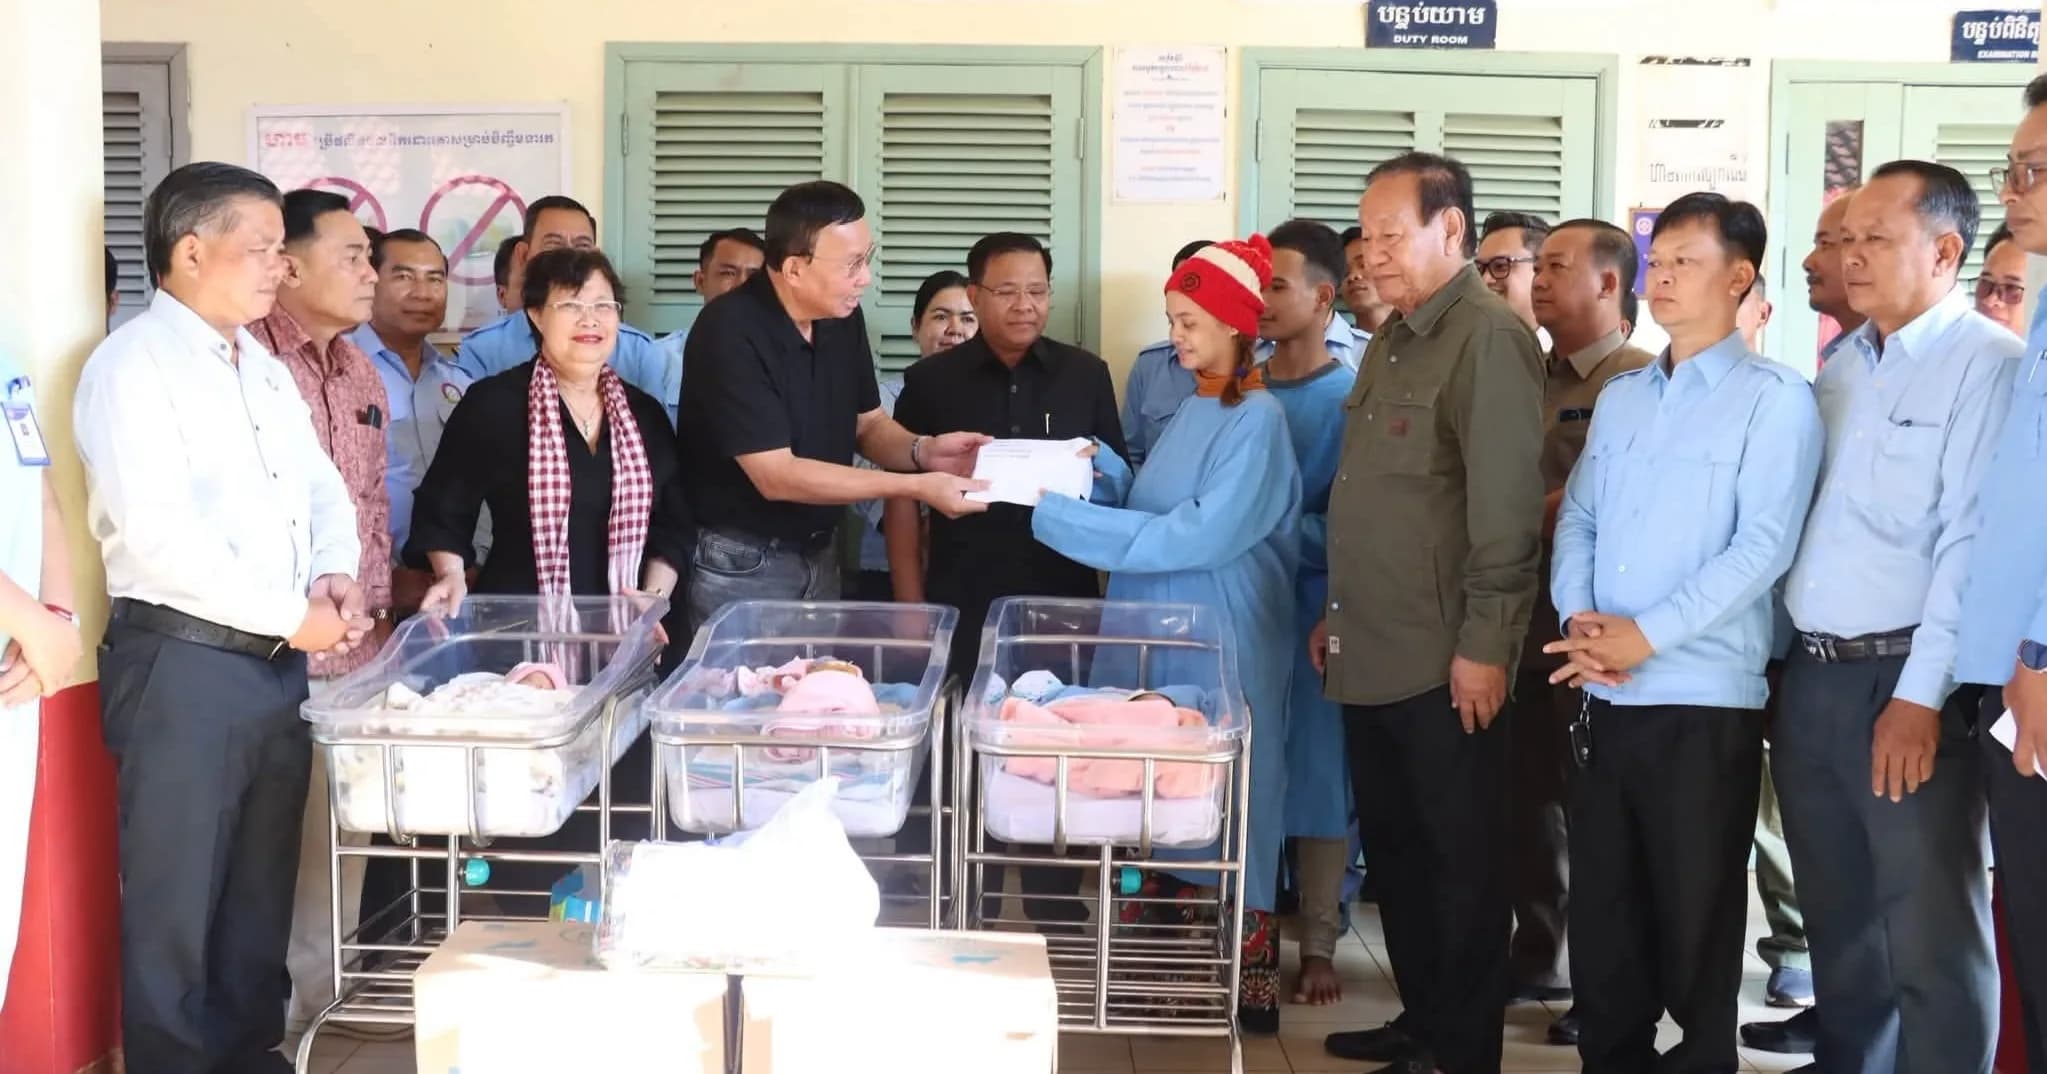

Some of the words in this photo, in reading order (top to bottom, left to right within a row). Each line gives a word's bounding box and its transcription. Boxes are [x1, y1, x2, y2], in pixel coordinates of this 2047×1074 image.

[1377, 2, 1486, 29] បន្ទប់យាម
[1393, 35, 1428, 44] DUTY
[1431, 35, 1468, 44] ROOM
